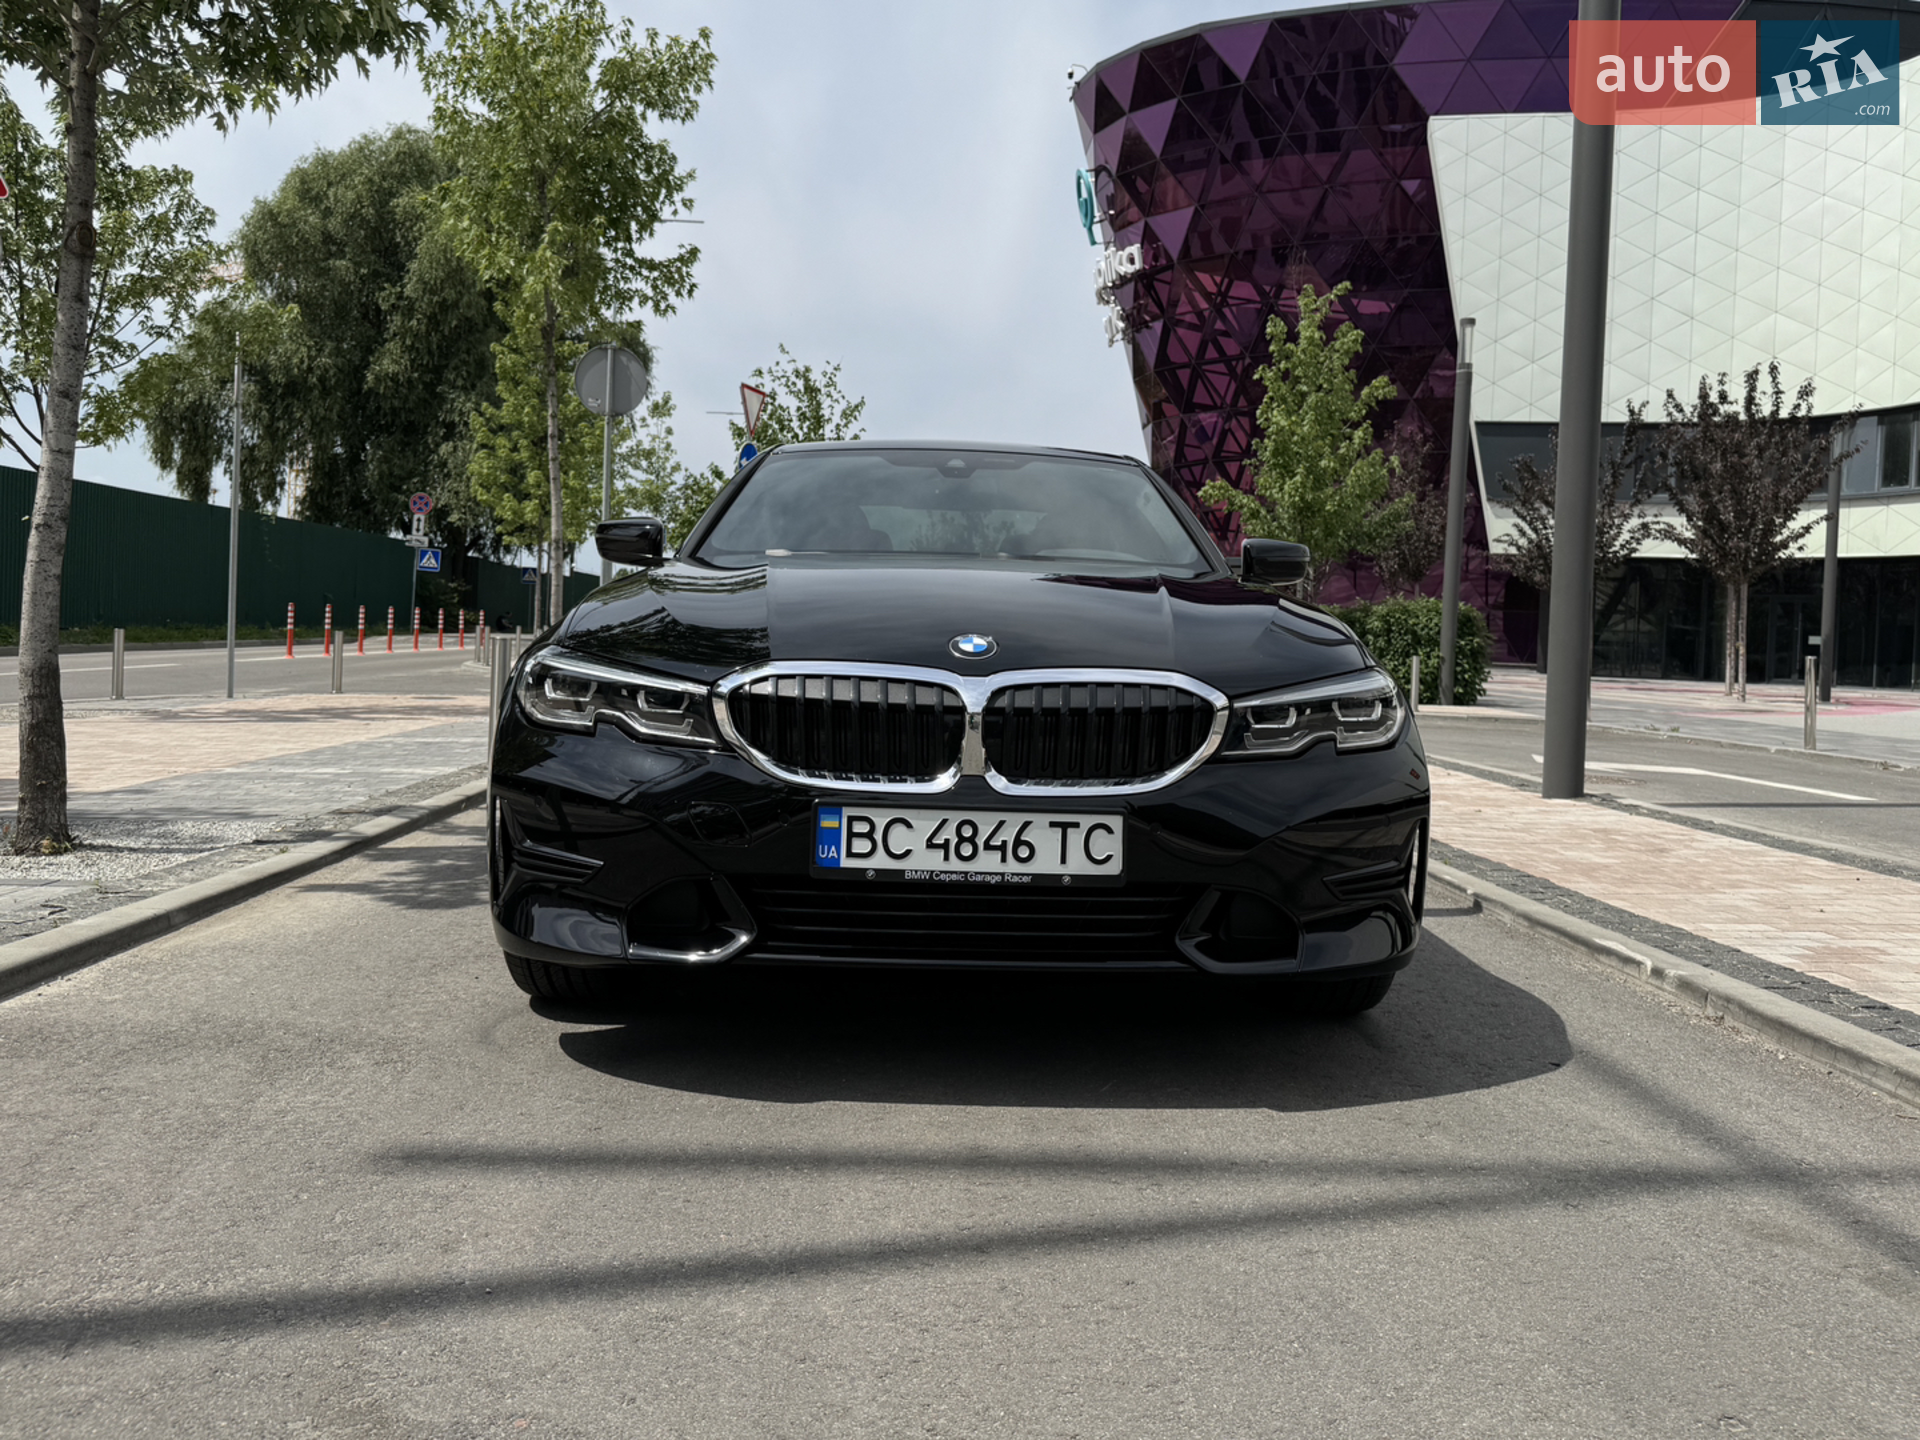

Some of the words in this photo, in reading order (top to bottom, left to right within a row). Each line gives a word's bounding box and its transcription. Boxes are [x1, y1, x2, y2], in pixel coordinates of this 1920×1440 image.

[846, 815, 914, 860] BC
[925, 817, 1036, 863] 4846
[1048, 820, 1116, 865] TC
[818, 844, 839, 859] UA
[904, 870, 931, 880] BMW
[967, 872, 1002, 884] Garage
[1004, 873, 1033, 883] Racer
